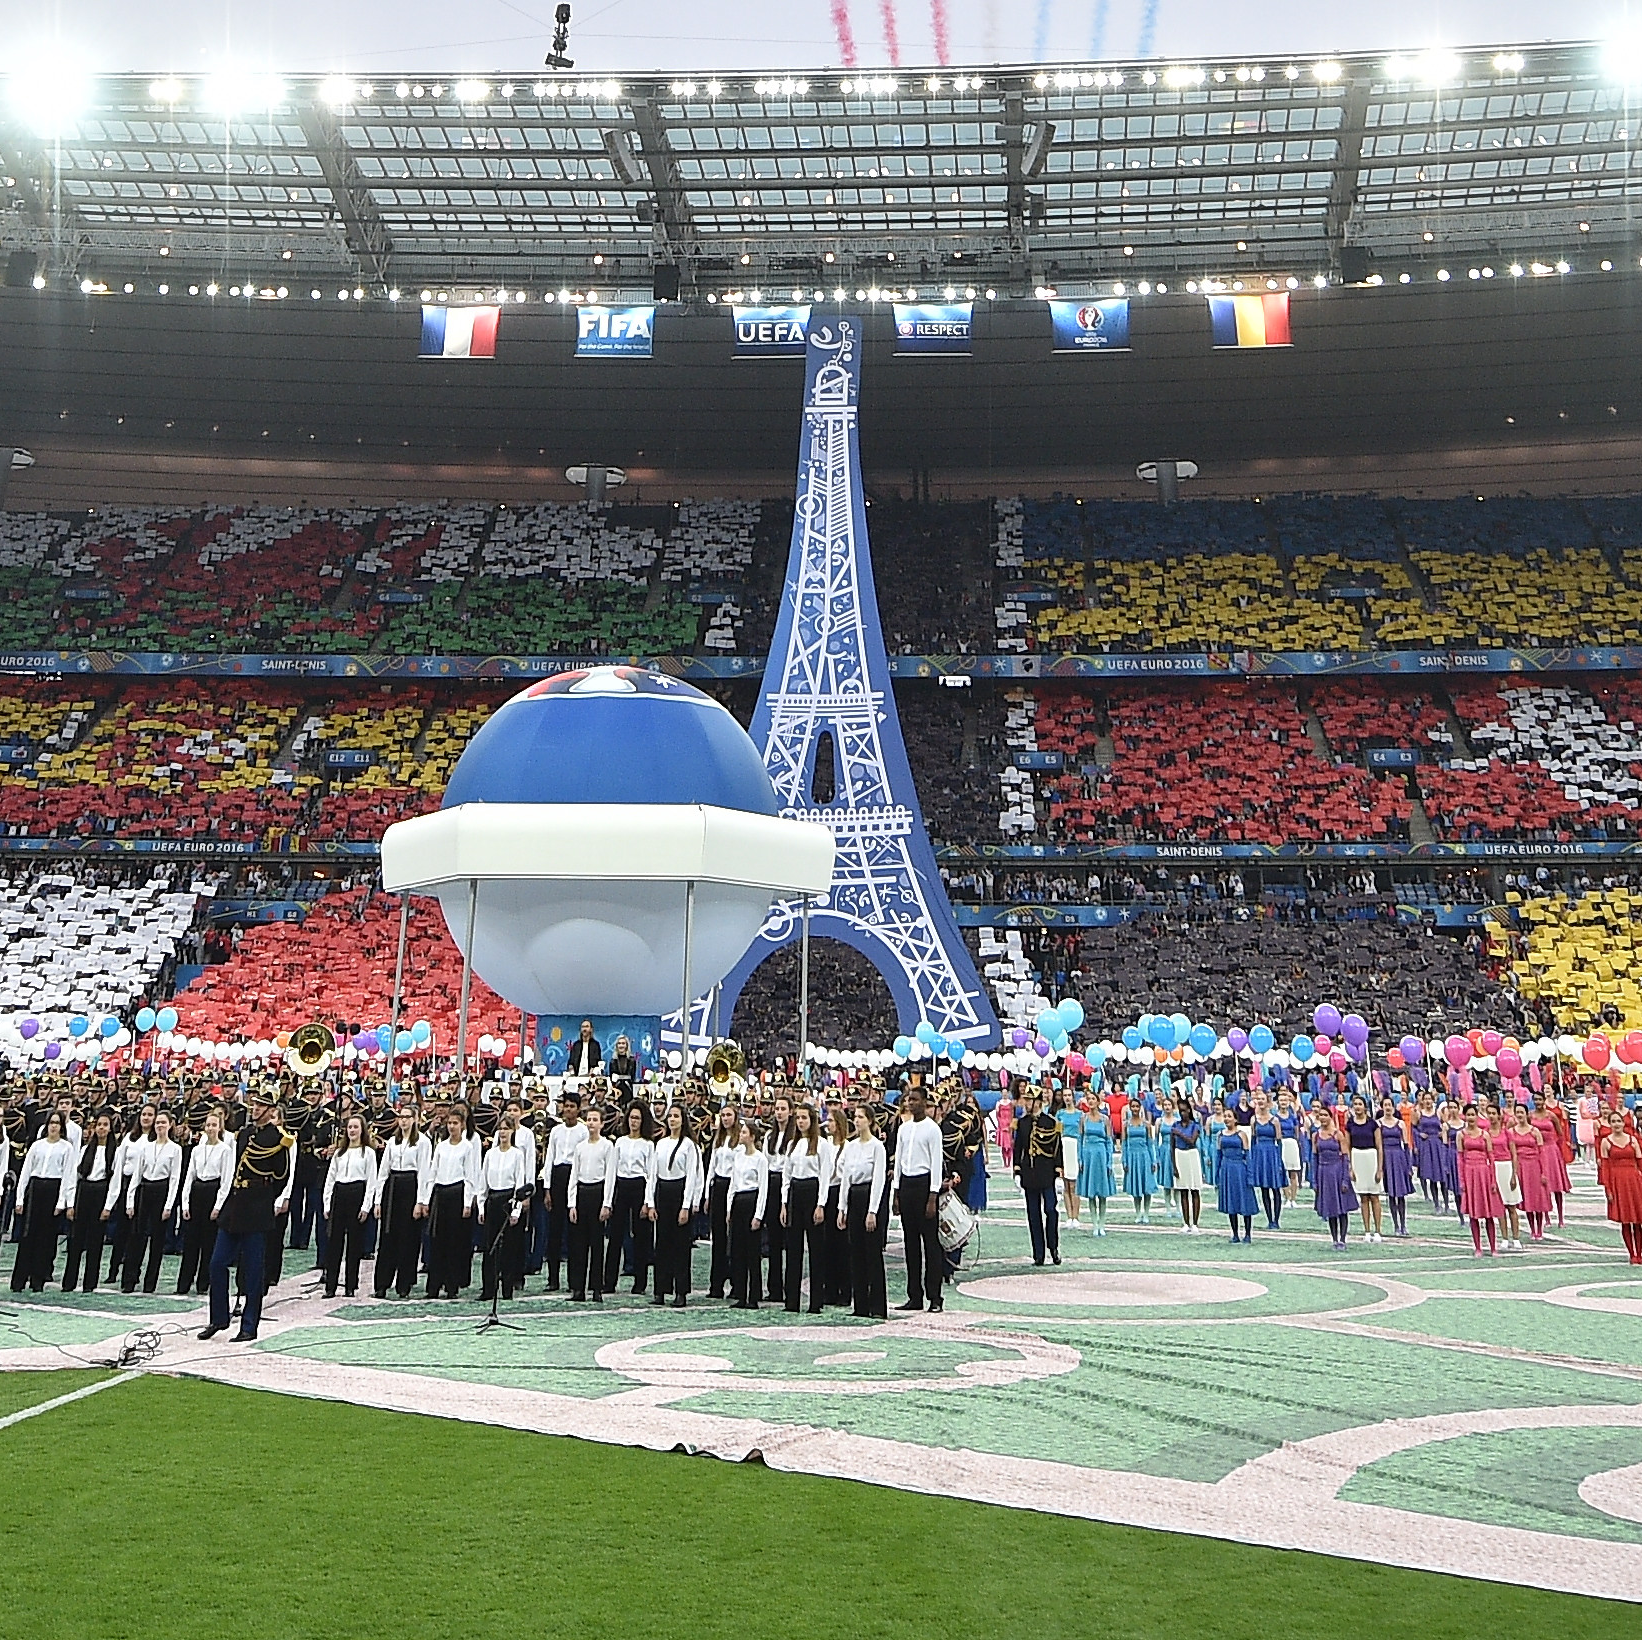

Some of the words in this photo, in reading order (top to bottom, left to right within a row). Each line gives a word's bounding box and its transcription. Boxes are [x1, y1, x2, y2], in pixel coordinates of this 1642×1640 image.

[579, 314, 651, 339] FIFA
[738, 322, 805, 342] UEFA
[916, 324, 969, 336] RESPECT
[26, 656, 55, 667] 2016
[262, 659, 326, 671] SAINT-NIS
[532, 661, 561, 671] UEFA
[1107, 660, 1139, 670] UEFA
[1140, 659, 1173, 670] EURO
[1175, 659, 1205, 670] 2016
[1419, 656, 1489, 667] SAINDENIS
[328, 753, 346, 763] E12
[354, 753, 370, 763] E11
[1019, 756, 1032, 764] E6
[1044, 756, 1057, 764] E5
[1373, 752, 1386, 761] E4
[1400, 752, 1412, 761] E3
[152, 842, 181, 852] UEFA
[183, 842, 213, 852] EURO
[215, 842, 245, 853] 2016
[1157, 846, 1223, 857] SAINT-DENIS
[1485, 845, 1517, 855] UEFA
[1518, 845, 1551, 855] EURO
[1553, 844, 1584, 854] 2016
